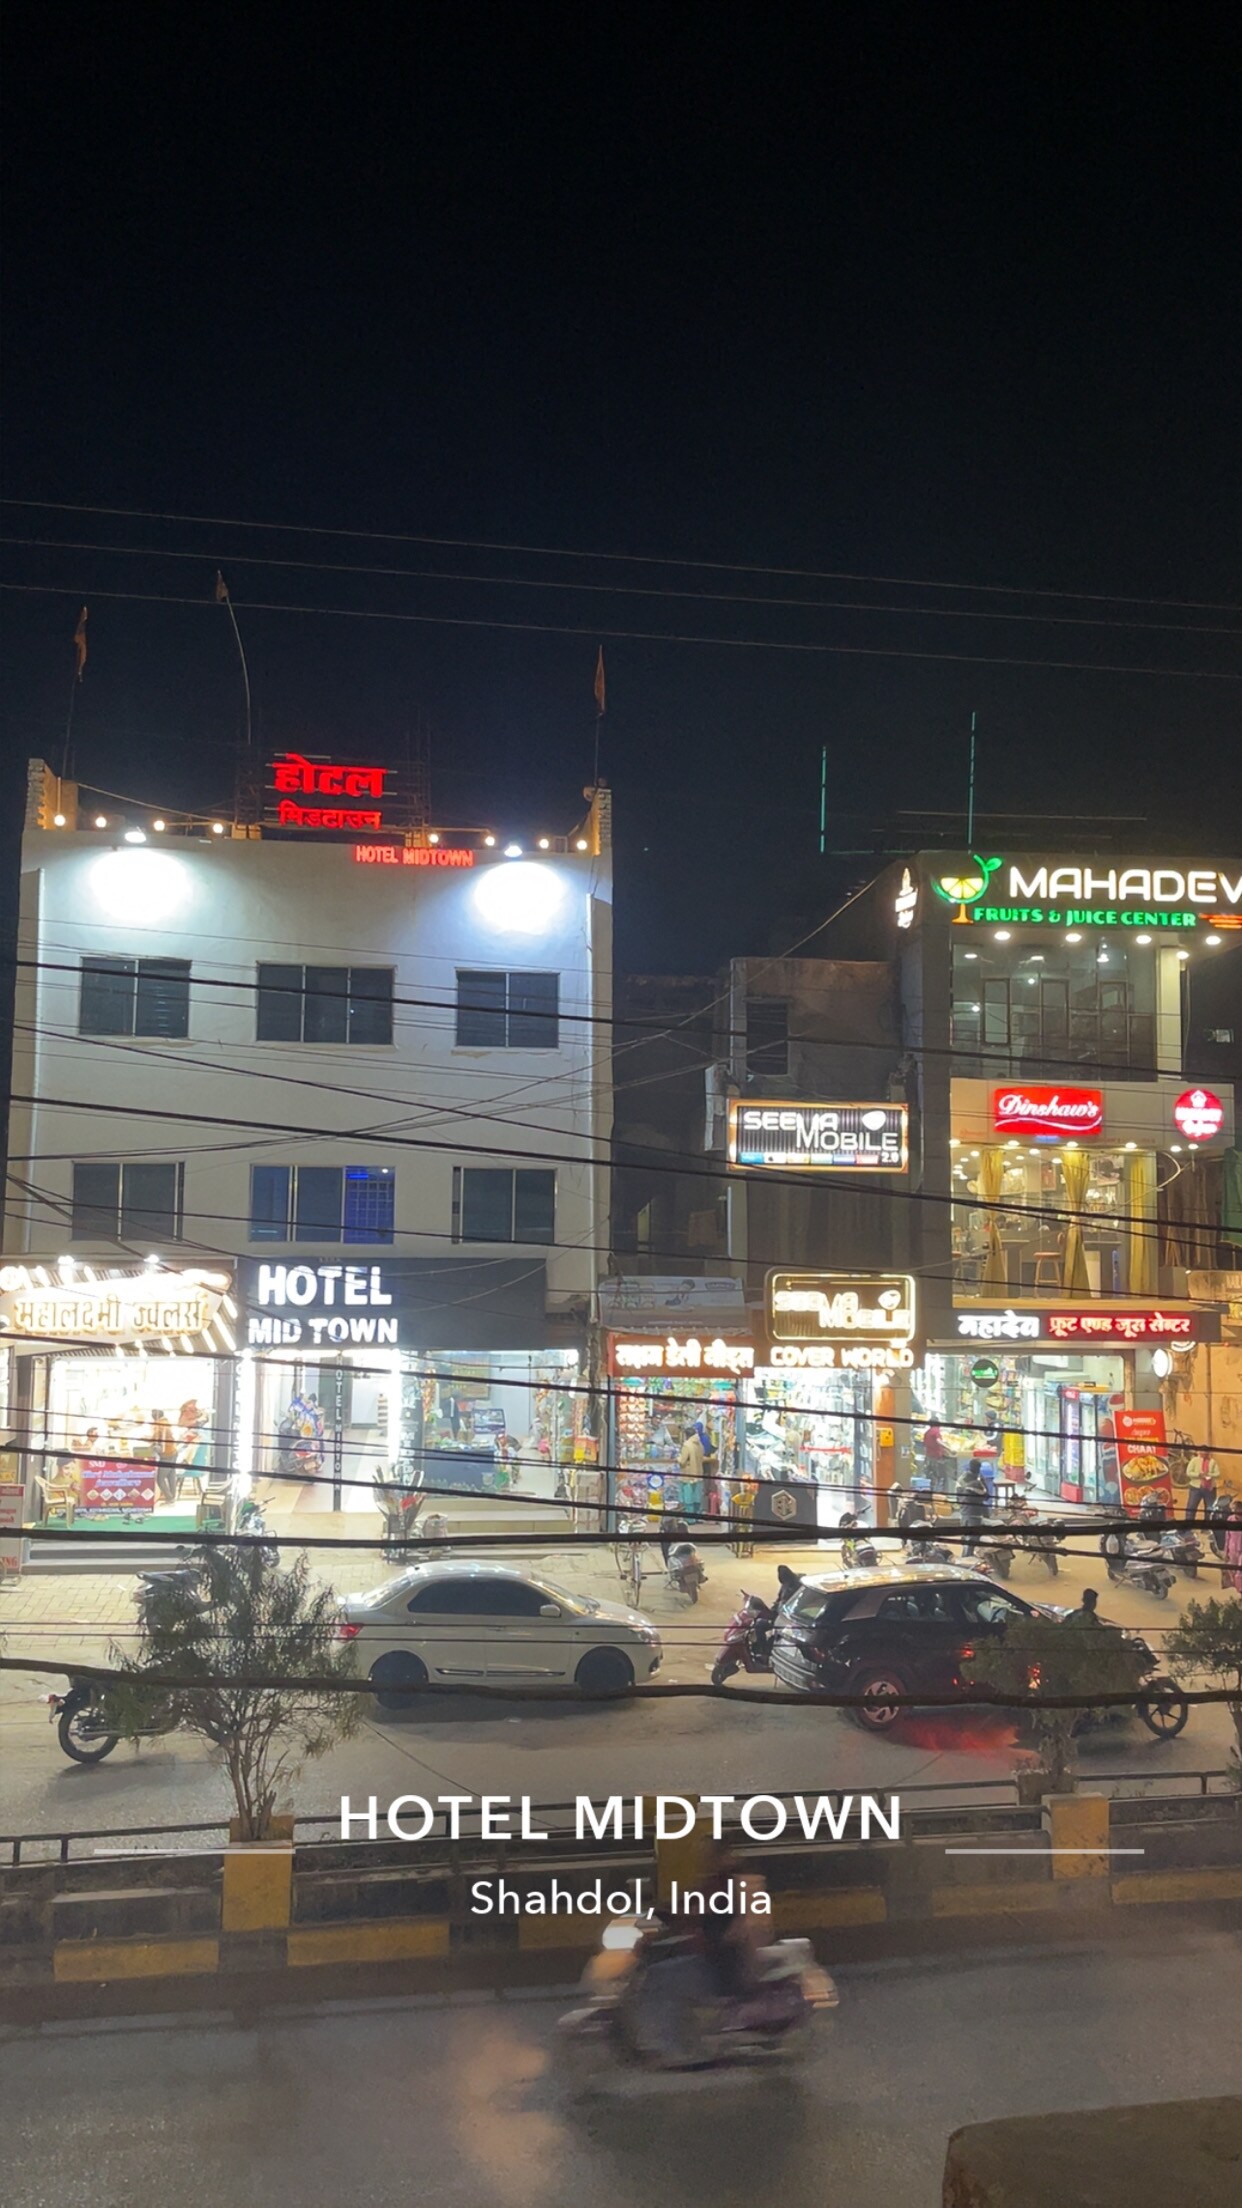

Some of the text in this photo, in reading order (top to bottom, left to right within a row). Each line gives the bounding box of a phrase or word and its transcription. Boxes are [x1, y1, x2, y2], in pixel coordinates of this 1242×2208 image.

[273, 753, 387, 798] होटल
[277, 799, 382, 831] मिडटाउन
[356, 845, 474, 866] HOTEL MIDTOWN
[1009, 866, 1242, 904] MAHADEV
[973, 906, 1196, 927] FRUITS & JUICE CENTER
[998, 1093, 1100, 1117] Dinshaw's
[743, 1111, 839, 1132] SEEMA
[796, 1125, 900, 1151] MOBILE
[258, 1265, 392, 1306] HOTEL
[248, 1317, 399, 1344] MID TOWN
[957, 1309, 1040, 1338] महादेव
[1049, 1316, 1078, 1337] फ्रूट
[1114, 1318, 1146, 1338] जूस
[770, 1346, 835, 1367] COVER
